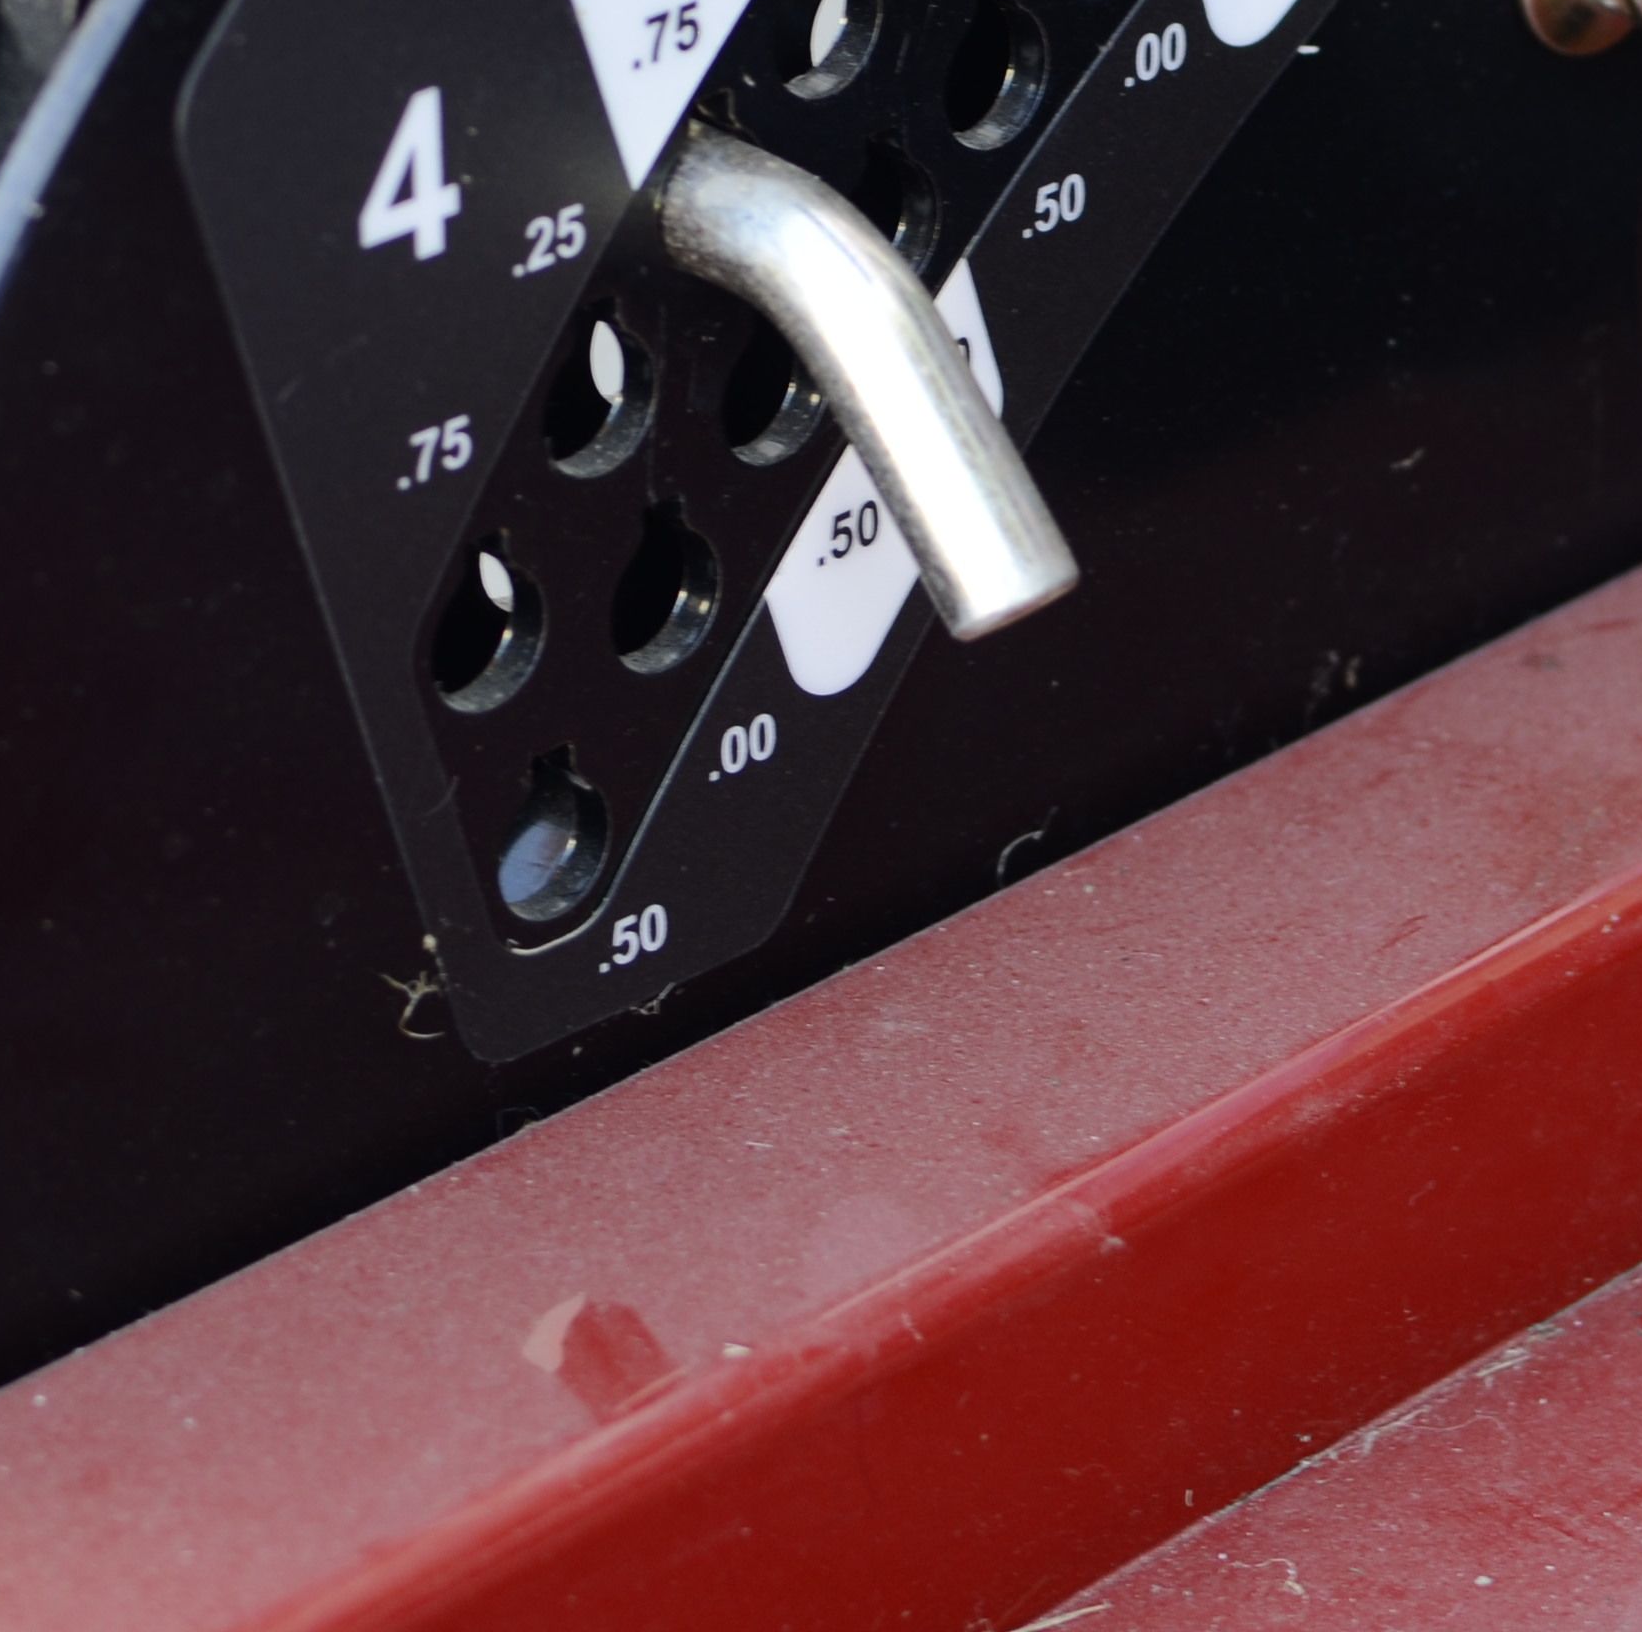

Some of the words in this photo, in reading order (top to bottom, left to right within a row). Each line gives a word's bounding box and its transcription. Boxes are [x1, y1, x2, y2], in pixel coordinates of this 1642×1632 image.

[634, 1, 700, 69] .75
[1124, 22, 1186, 87] .00
[358, 85, 461, 261] 4
[1021, 173, 1086, 239] .50
[512, 203, 586, 278] .25
[397, 414, 473, 491] .75
[818, 500, 879, 567] .50
[709, 713, 776, 782] .00
[599, 904, 667, 974] .50
